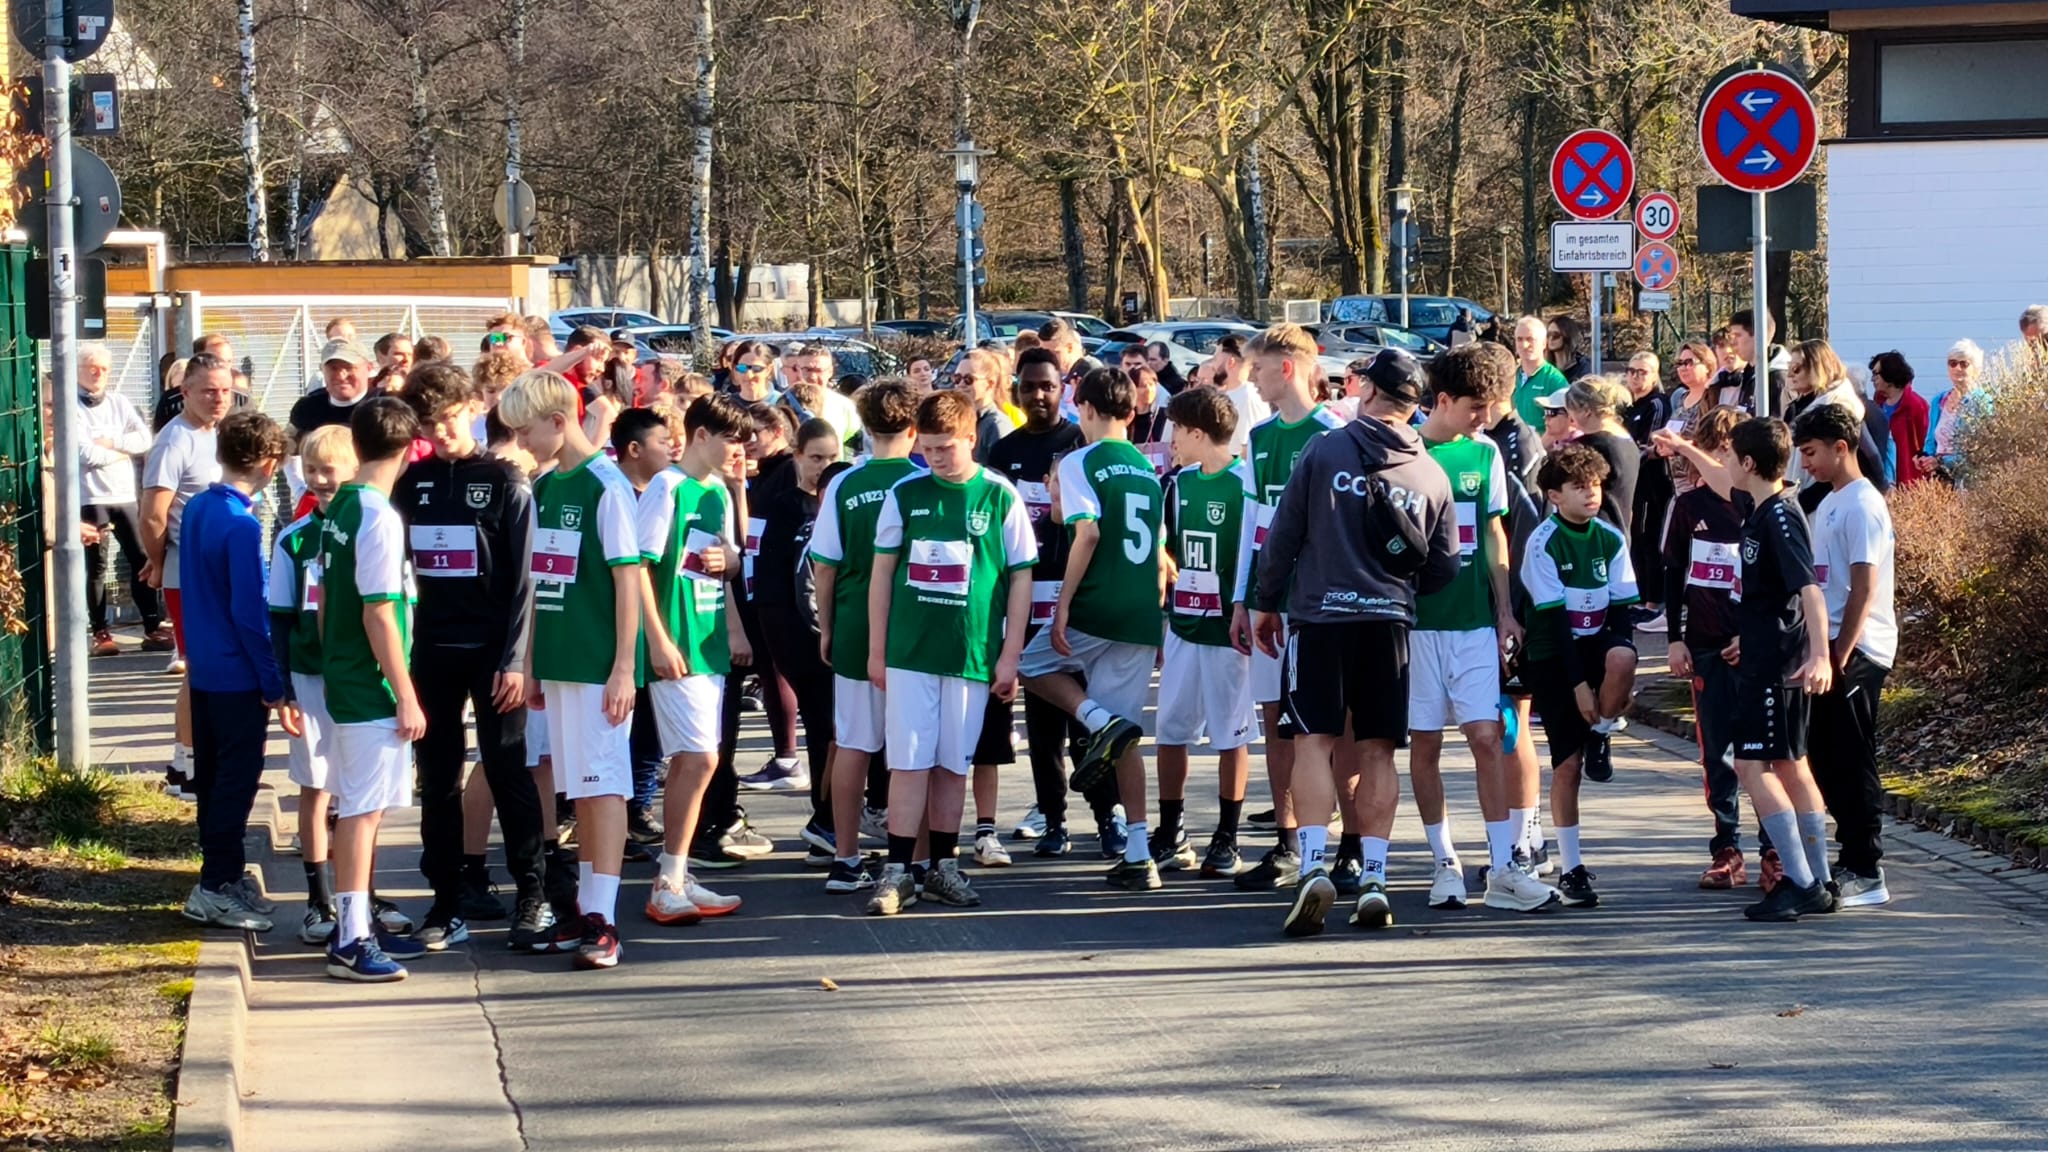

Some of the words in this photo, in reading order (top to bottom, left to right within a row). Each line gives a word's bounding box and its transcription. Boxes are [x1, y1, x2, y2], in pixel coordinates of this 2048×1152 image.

[1645, 206, 1670, 227] 30
[1566, 234, 1577, 244] im
[1579, 234, 1619, 247] gesamten
[1558, 250, 1627, 261] Einfahrtsbereich
[1094, 470, 1109, 483] SV
[1333, 471, 1425, 514] COCH
[845, 496, 859, 511] SV
[859, 489, 884, 505] 1923
[1123, 492, 1152, 565] 5
[433, 555, 449, 567] 11
[1187, 541, 1208, 569] HL
[546, 558, 554, 572] 9
[930, 569, 940, 581] 2
[1707, 567, 1724, 580] 19
[1189, 596, 1201, 608] 10
[1583, 616, 1591, 628] 8
[1743, 742, 1764, 751] JAKO
